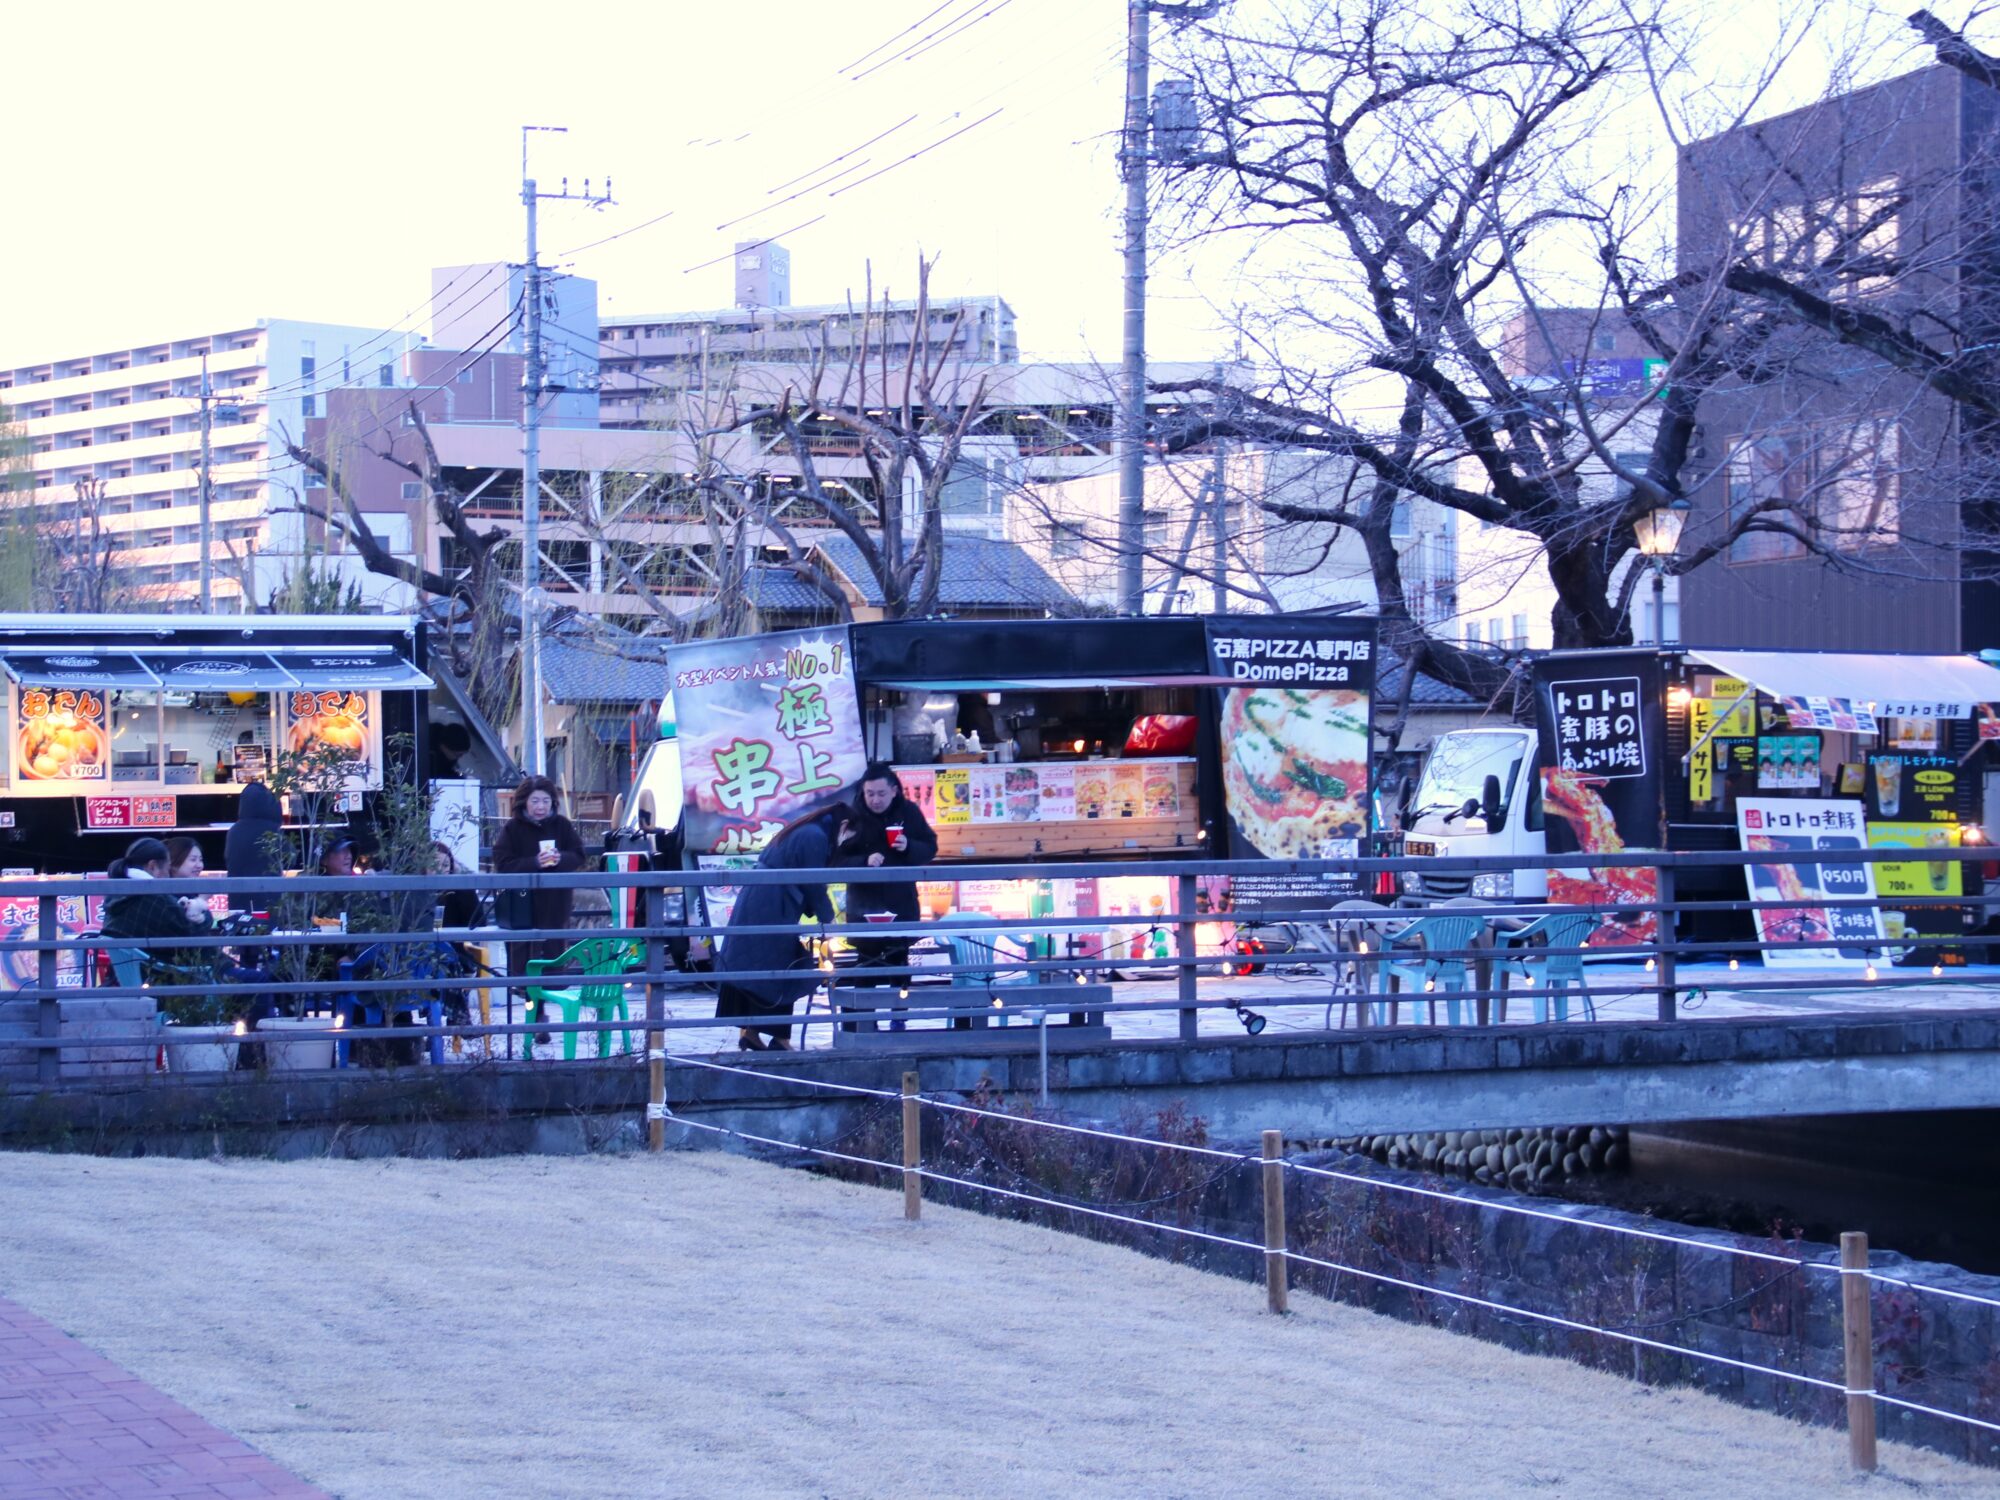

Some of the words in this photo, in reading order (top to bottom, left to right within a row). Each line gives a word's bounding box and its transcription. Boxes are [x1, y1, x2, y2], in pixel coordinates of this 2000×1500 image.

[1213, 638, 1371, 661] 石窯PIZZA専門店
[677, 661, 779, 689] 大型イベント人気
[786, 645, 842, 680] No.1
[1234, 661, 1349, 681] DomePizza
[22, 691, 103, 719] おでん
[291, 690, 367, 717] おでん
[1557, 689, 1635, 714] トロトロ
[1884, 703, 1960, 717] トロトロ煮豚
[1560, 714, 1635, 743] 煮豚の
[1562, 741, 1640, 771] あぶり焼
[1694, 702, 1708, 797] レモサワー
[75, 766, 100, 776] ¥700
[95, 807, 122, 817] ビール
[1766, 810, 1856, 830] トロトロ煮豚
[1823, 870, 1865, 884] 950円
